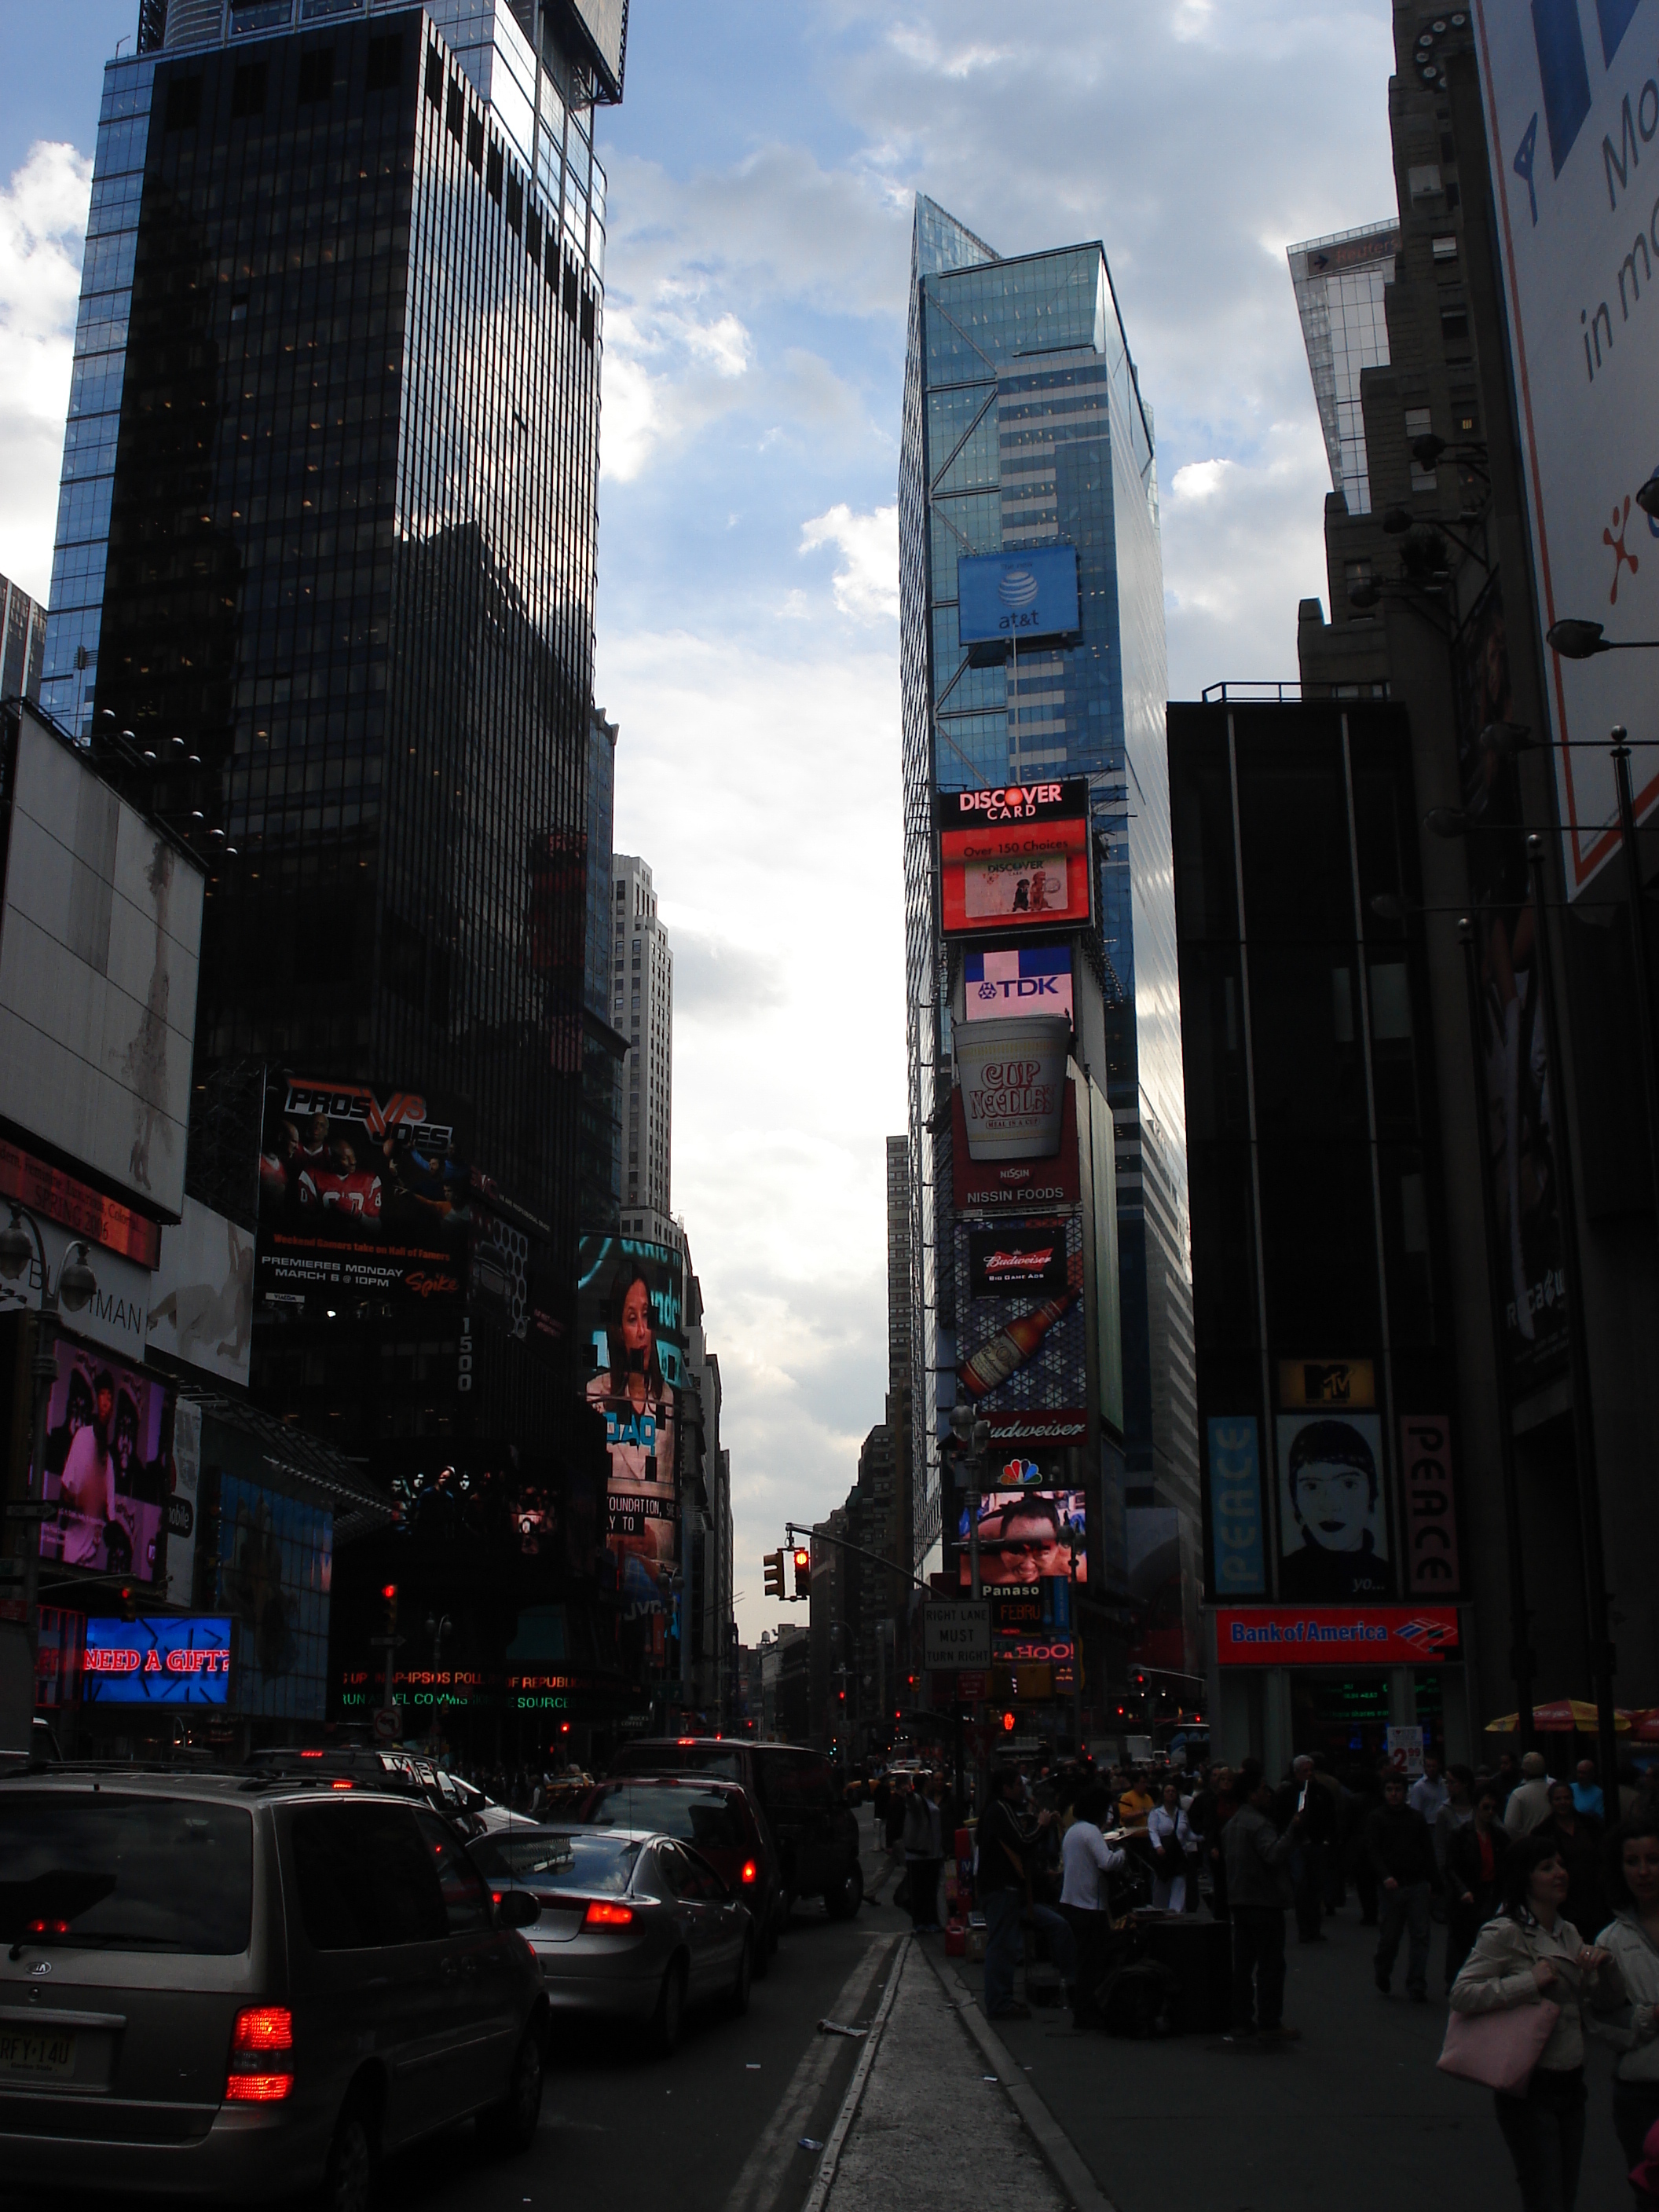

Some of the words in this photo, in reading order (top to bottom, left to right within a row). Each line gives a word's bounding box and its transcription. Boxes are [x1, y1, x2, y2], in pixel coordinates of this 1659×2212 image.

[1580, 302, 1613, 383] in
[998, 610, 1039, 629] at&t
[958, 783, 1063, 812] DISCOVER
[987, 804, 1037, 821] CARD
[964, 847, 992, 857] Over
[998, 842, 1020, 854] 150
[1024, 840, 1068, 852] Choices
[987, 860, 1044, 873] DISCOVER
[996, 976, 1059, 998] TDK
[982, 1060, 1041, 1090] CUP
[287, 1088, 373, 1119] PROS
[372, 1122, 452, 1152] JOES
[1000, 1168, 1030, 1180] NISSIN
[967, 1190, 1013, 1203] NISSIN
[1016, 1187, 1064, 1200] FOODS
[35, 1184, 82, 1228] SPRING
[84, 1210, 109, 1241] 2006
[273, 1233, 316, 1247] Weekend
[317, 1238, 353, 1251] Gamers
[353, 1242, 375, 1253] take
[375, 1245, 387, 1255] on
[388, 1246, 406, 1257] Hall
[407, 1248, 418, 1257] of
[419, 1249, 451, 1261] Famers
[262, 1256, 341, 1272] PREMIERES
[345, 1263, 404, 1278] MONDAY
[983, 1254, 1053, 1269] Budweiser
[275, 1269, 326, 1281] MARCH
[342, 1275, 352, 1284] @
[355, 1276, 390, 1288] 10PM
[405, 1270, 460, 1298] Spike
[457, 1317, 472, 1393] 1500
[1304, 1364, 1356, 1399] MTV
[606, 1494, 663, 1518] OUNDATION,
[1215, 1426, 1258, 1582] PEACE
[1408, 1426, 1452, 1580] PEACE
[622, 1516, 635, 1531] TO
[983, 1585, 1040, 1597] Panaso
[926, 1610, 956, 1621] RIGHT
[961, 1609, 987, 1621] LANE
[1000, 1604, 1041, 1621] FEBRU
[939, 1629, 974, 1643] MUST
[1230, 1622, 1281, 1643] Bank
[1281, 1621, 1304, 1642] of
[1306, 1621, 1388, 1642] America
[83, 1650, 141, 1672] NEED
[144, 1650, 163, 1672] A
[166, 1650, 230, 1672] GIFT?
[927, 1650, 954, 1662] TURN
[958, 1650, 988, 1661] RIGHT
[993, 1642, 1075, 1661] AHOO!
[454, 1672, 482, 1686] POLL
